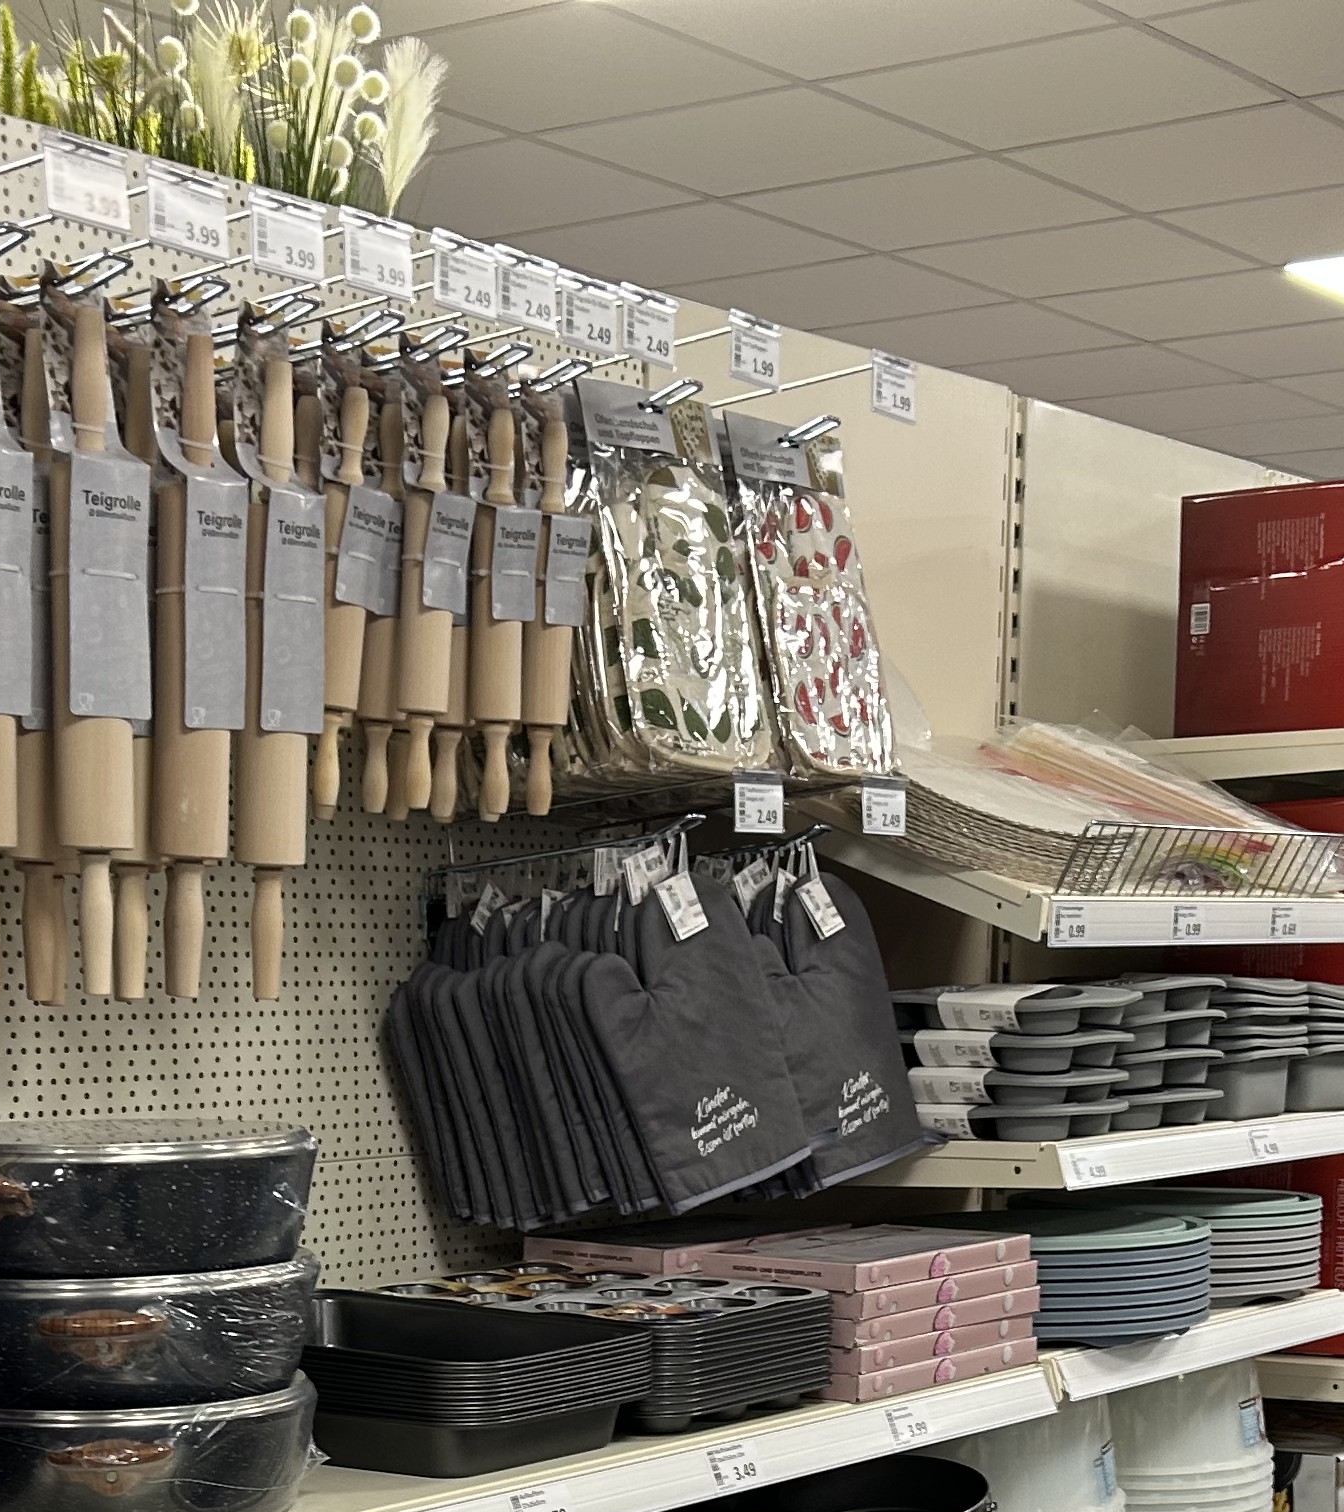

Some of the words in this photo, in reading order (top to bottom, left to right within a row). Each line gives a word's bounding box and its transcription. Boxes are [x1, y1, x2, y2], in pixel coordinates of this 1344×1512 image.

[185, 220, 220, 248] 3.99
[285, 246, 315, 271] 3.99
[376, 263, 405, 288] 3.99
[464, 285, 491, 308] 2.49
[525, 299, 551, 322] 2.49
[586, 321, 611, 345] 2.49
[645, 334, 669, 357] 2.49
[752, 358, 774, 378] 1.99
[82, 489, 142, 511] Teigrolle
[197, 510, 242, 530] Teigrolle
[278, 519, 320, 540] Teigrolle
[757, 810, 778, 825] 2.49
[882, 812, 899, 828] 2.49
[733, 1462, 756, 1480] 3.49
